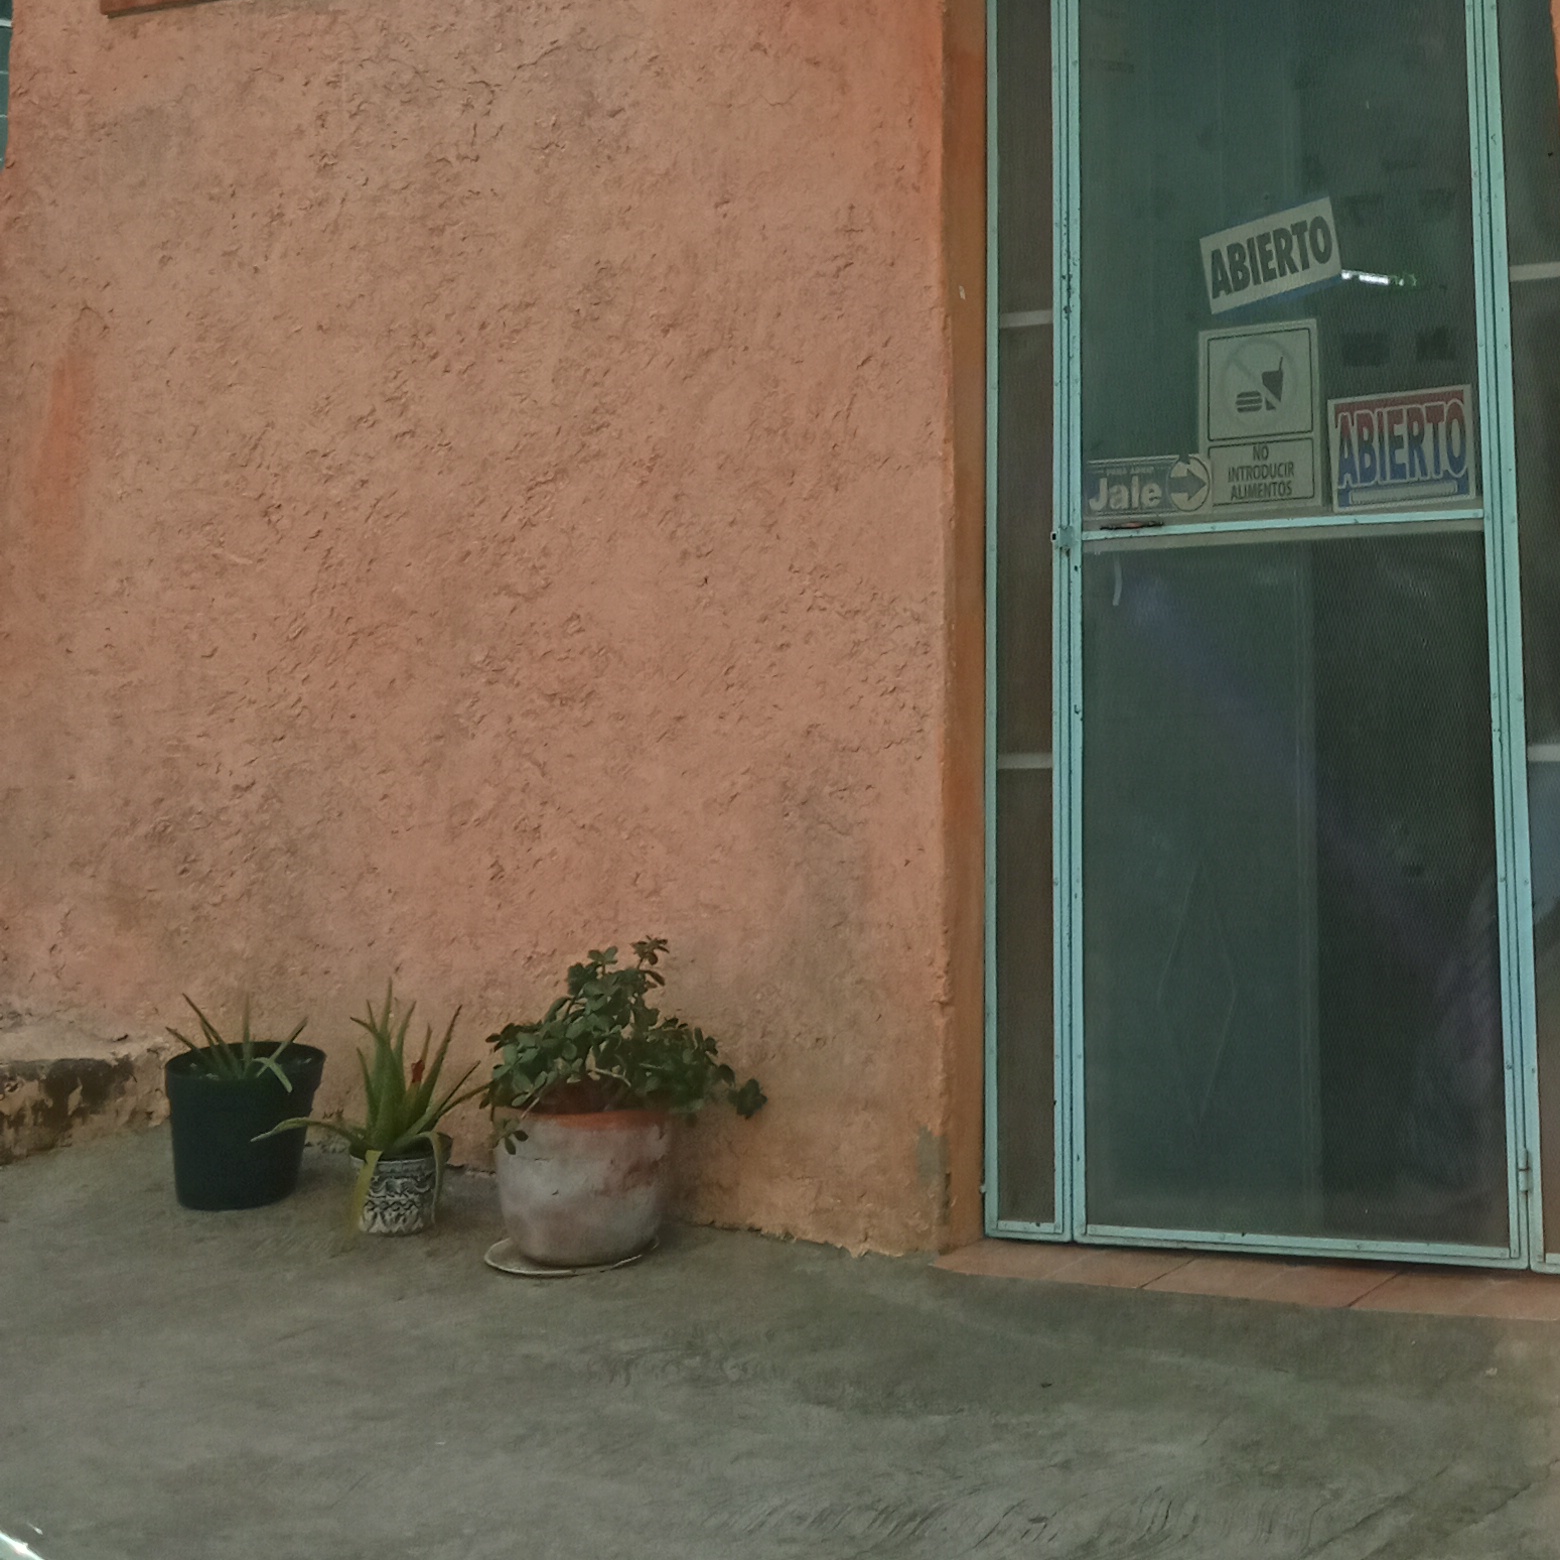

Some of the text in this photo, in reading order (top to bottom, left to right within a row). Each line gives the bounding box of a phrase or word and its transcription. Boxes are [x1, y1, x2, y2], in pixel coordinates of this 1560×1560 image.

[1209, 214, 1333, 300] ABIERTO
[1252, 444, 1269, 461] NO
[1338, 398, 1468, 489] ABIERTO
[1227, 461, 1295, 483] INTRODUCIR
[1087, 474, 1163, 511] Jale
[1230, 480, 1293, 502] ALIMENTOS
